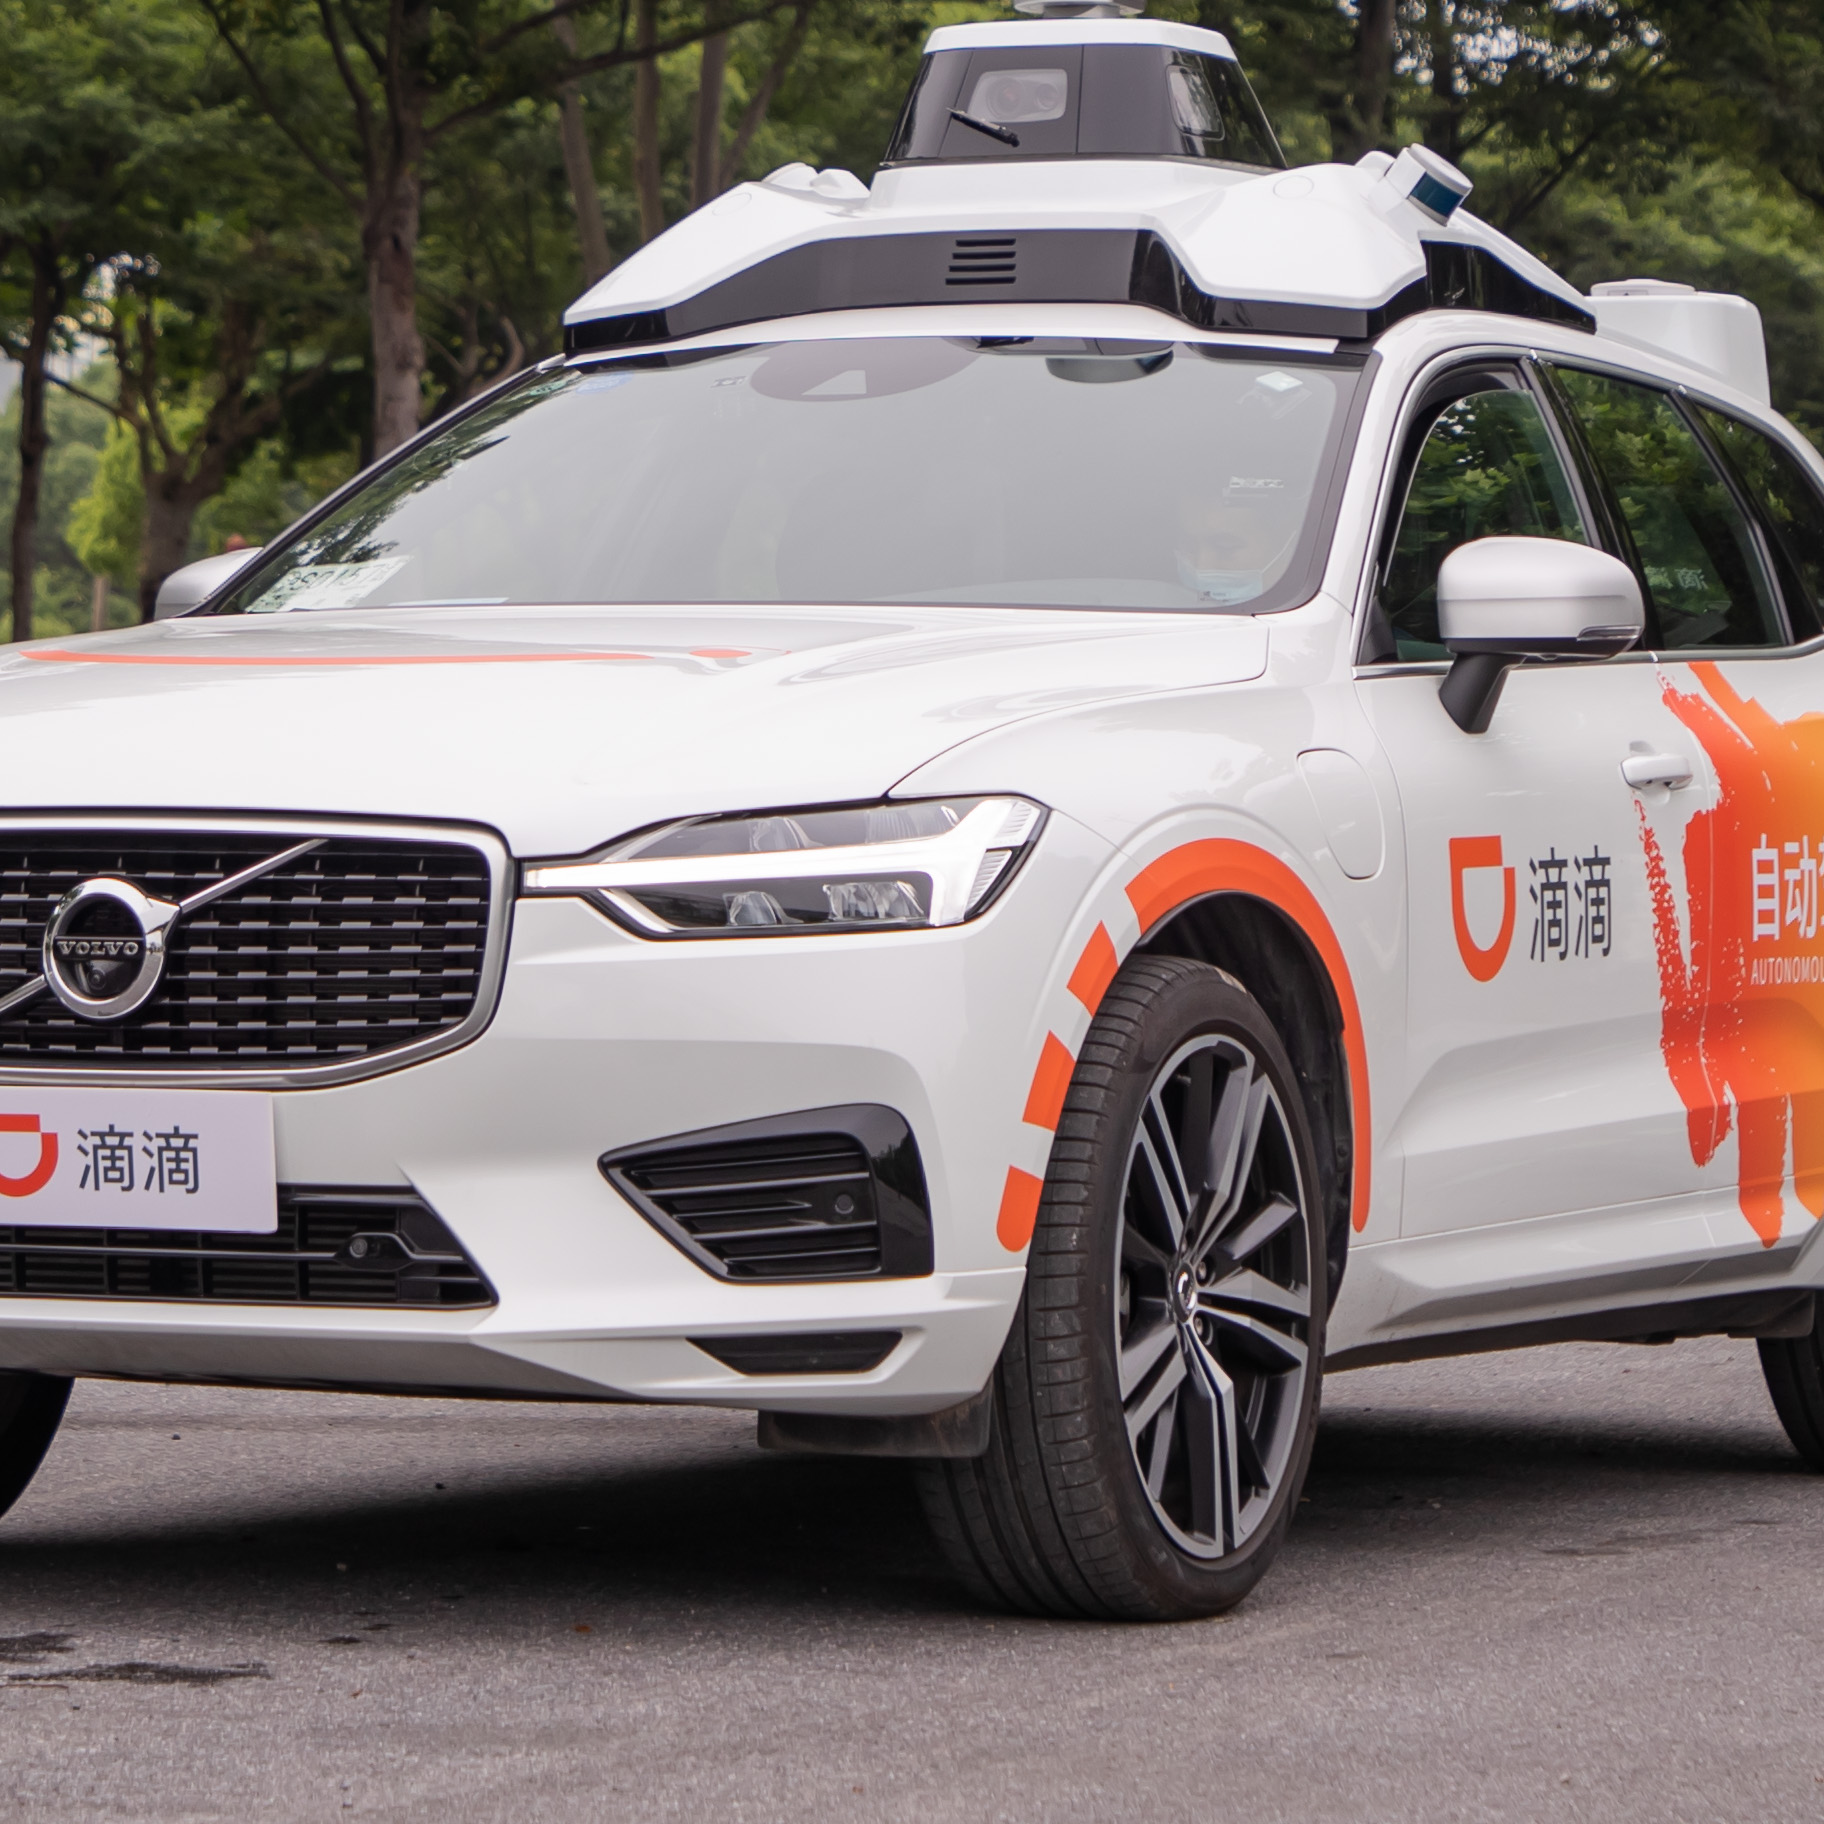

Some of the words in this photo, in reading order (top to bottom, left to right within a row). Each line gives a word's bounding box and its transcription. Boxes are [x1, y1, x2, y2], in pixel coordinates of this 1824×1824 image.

[1529, 845, 1612, 962] 滴滴
[57, 941, 139, 956] VOLVO
[77, 1124, 200, 1195] 滴滴
